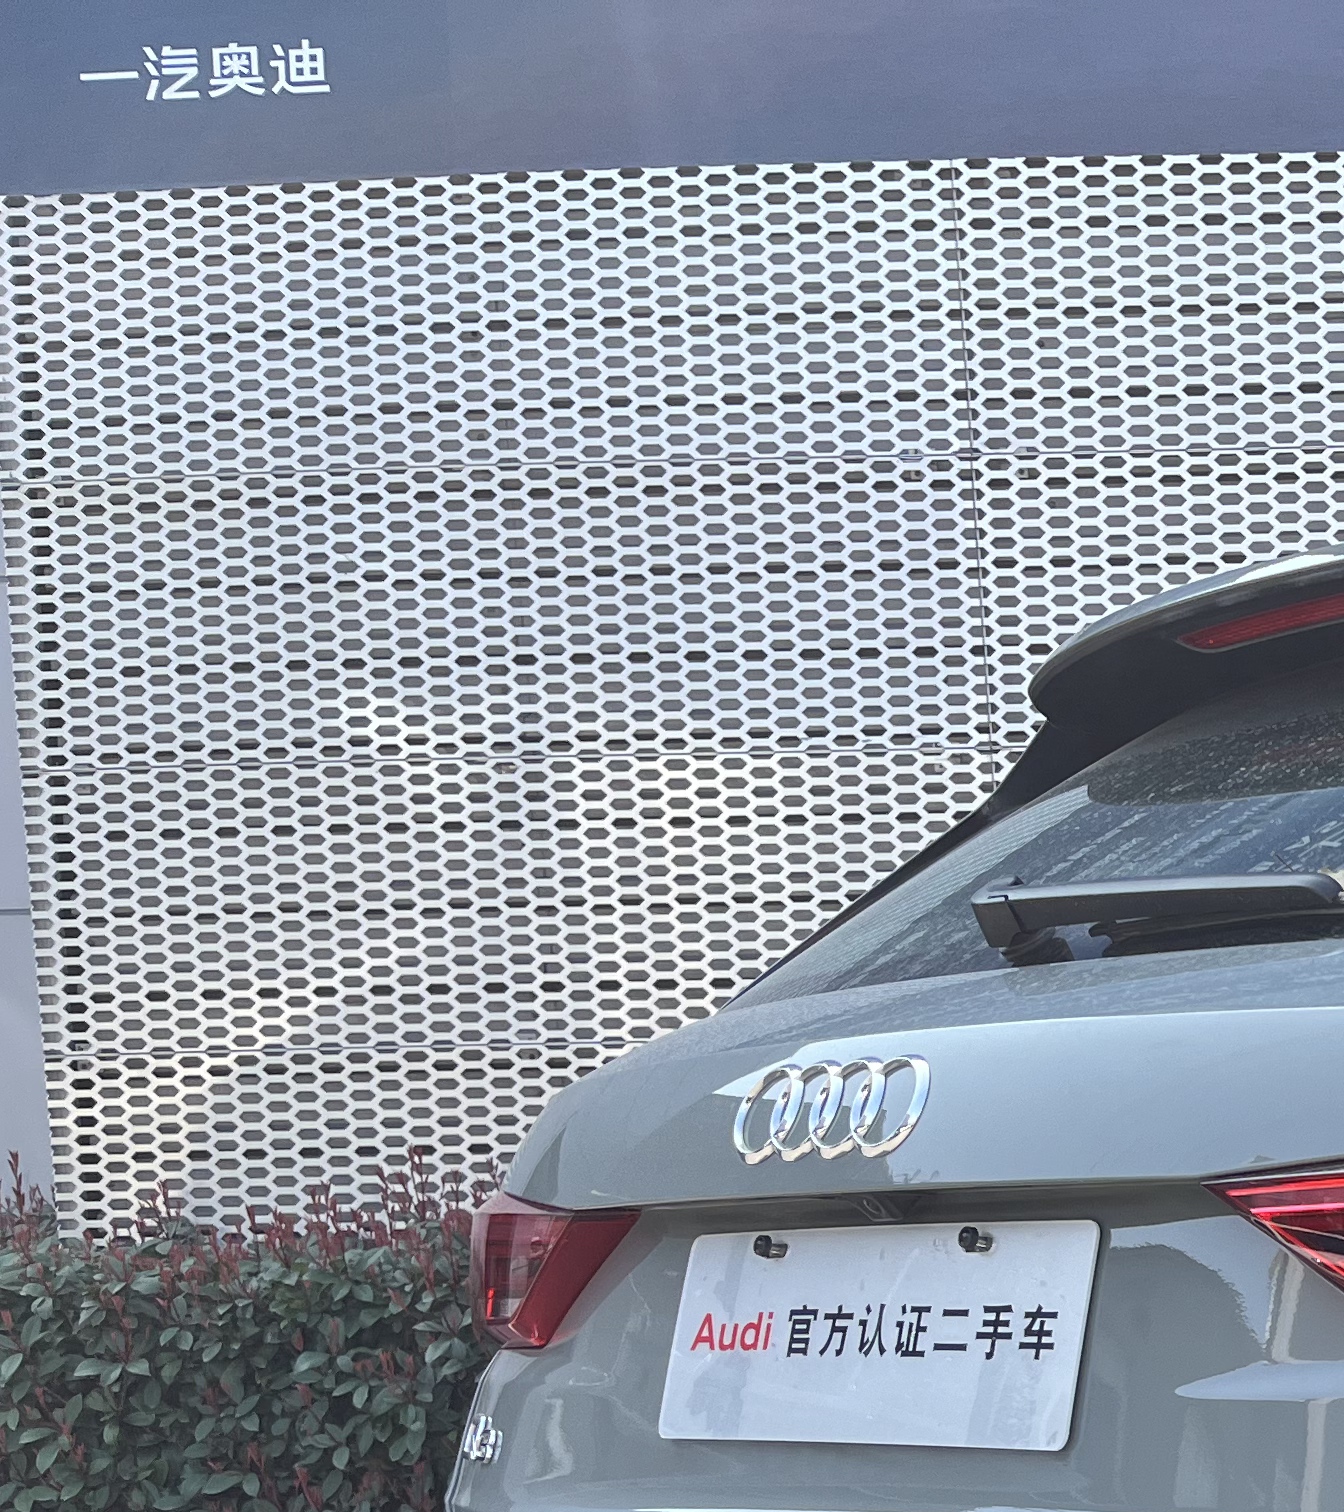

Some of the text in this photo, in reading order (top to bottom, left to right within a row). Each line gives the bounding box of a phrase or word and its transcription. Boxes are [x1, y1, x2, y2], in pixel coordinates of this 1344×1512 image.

[79, 38, 331, 101] 一汽奥迪
[690, 1304, 1059, 1360] Audi 官方认证二手车
